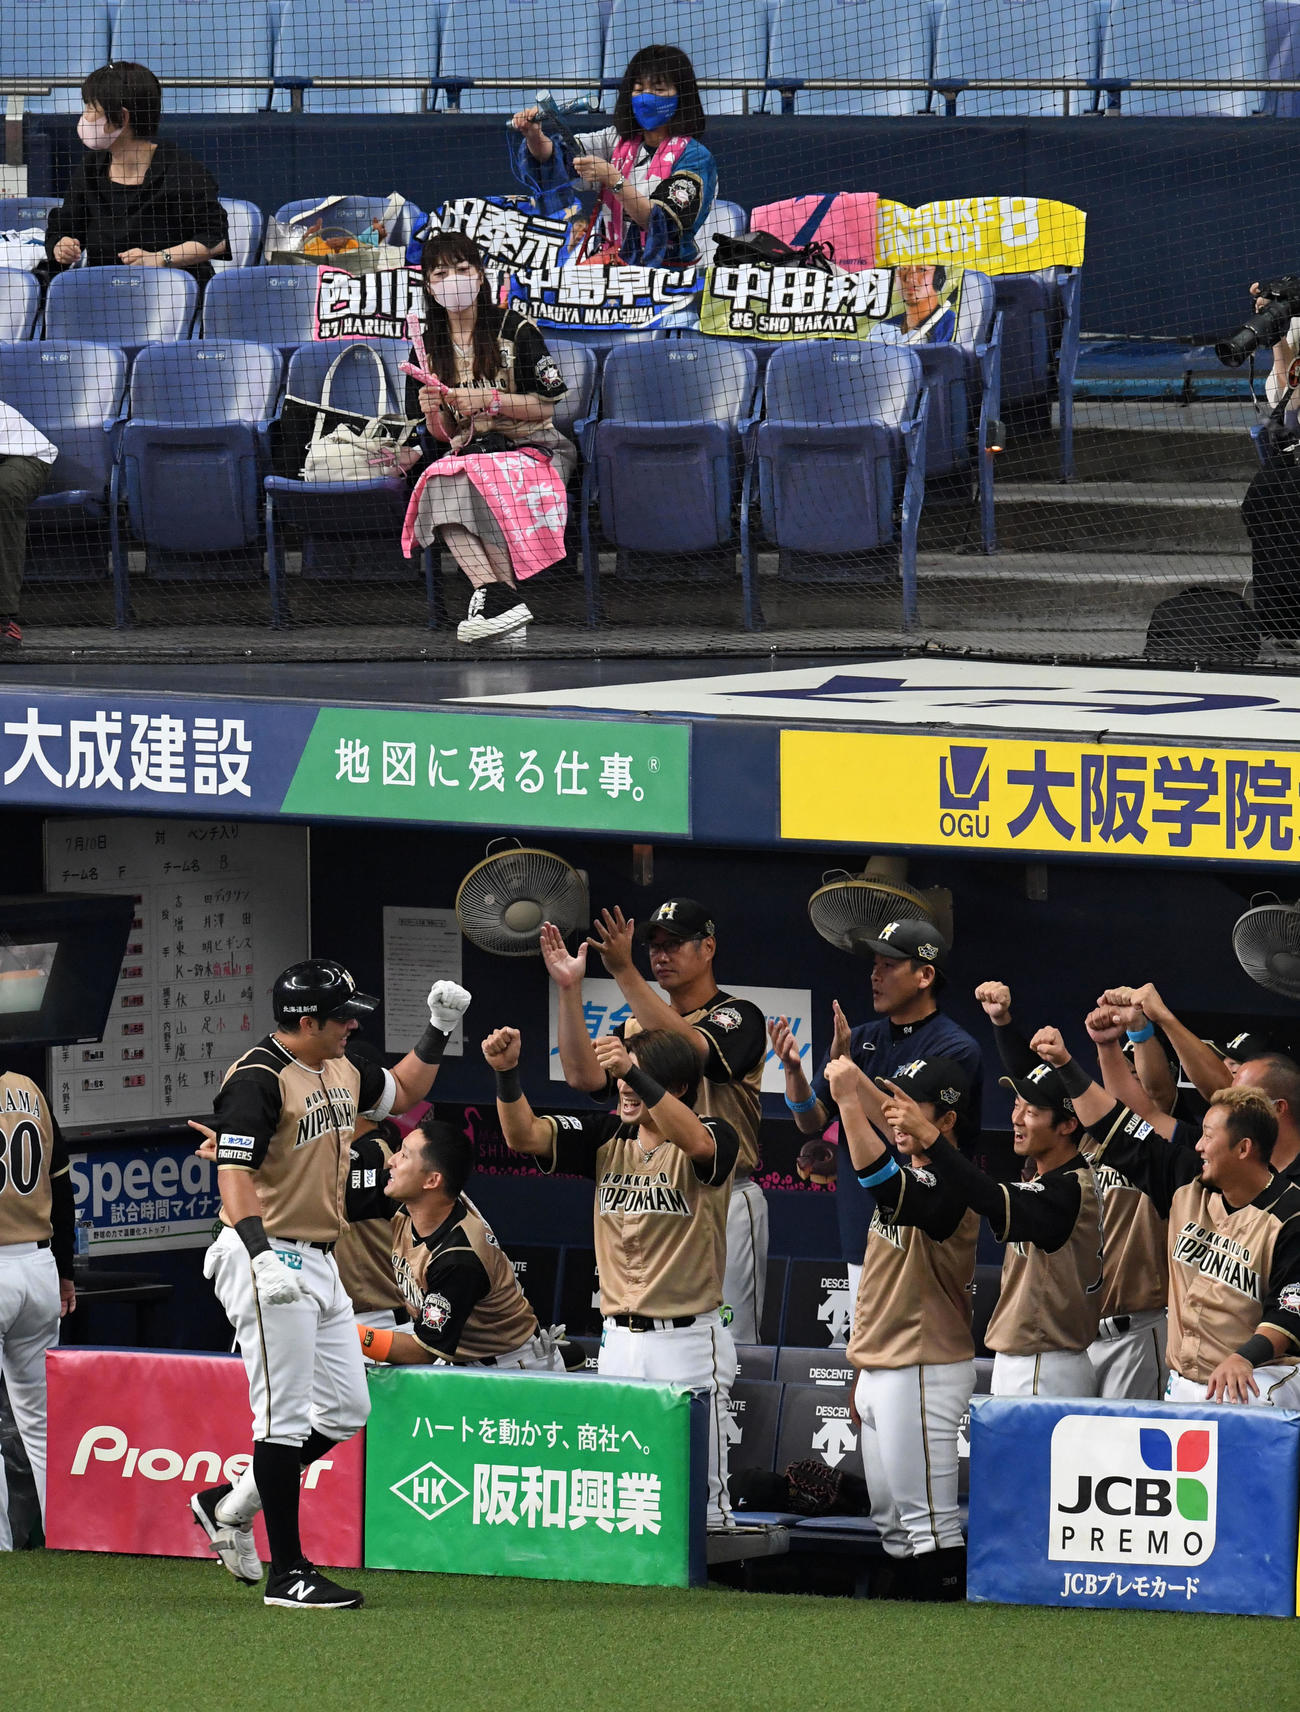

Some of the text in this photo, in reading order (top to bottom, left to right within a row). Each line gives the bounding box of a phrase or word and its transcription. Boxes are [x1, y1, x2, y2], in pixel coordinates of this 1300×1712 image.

[876, 196, 1040, 247] ENSUKE 8
[879, 222, 984, 258] ONDOH
[712, 265, 893, 318] 中田翔
[344, 318, 402, 338] HARUKI
[531, 302, 581, 324] TAKUYA
[585, 308, 654, 325] NAKASHIMA
[731, 313, 855, 333] #6 SHO NAKATA
[3, 707, 252, 798] 大成建設
[335, 738, 645, 802] 地図に残る仕事。
[1006, 749, 1300, 851] 大阪学院
[939, 813, 990, 839] OGU
[62, 866, 99, 882] チーム名
[162, 856, 201, 874] チーム名
[0, 1087, 41, 1121] AMA
[820, 1278, 851, 1290] DESCE
[809, 1367, 854, 1380] DESCENTE
[815, 1405, 850, 1418] DESCEN
[412, 1416, 650, 1456] ハートを動かす、商社へ。
[70, 1425, 334, 1490] Pioner
[412, 1477, 448, 1505] HK
[472, 1463, 662, 1535] 阪和興業
[1057, 1475, 1173, 1518] JCB
[1061, 1525, 1204, 1557] PREMO
[287, 1579, 316, 1601] N
[1060, 1572, 1201, 1601] JCBプレモカード
